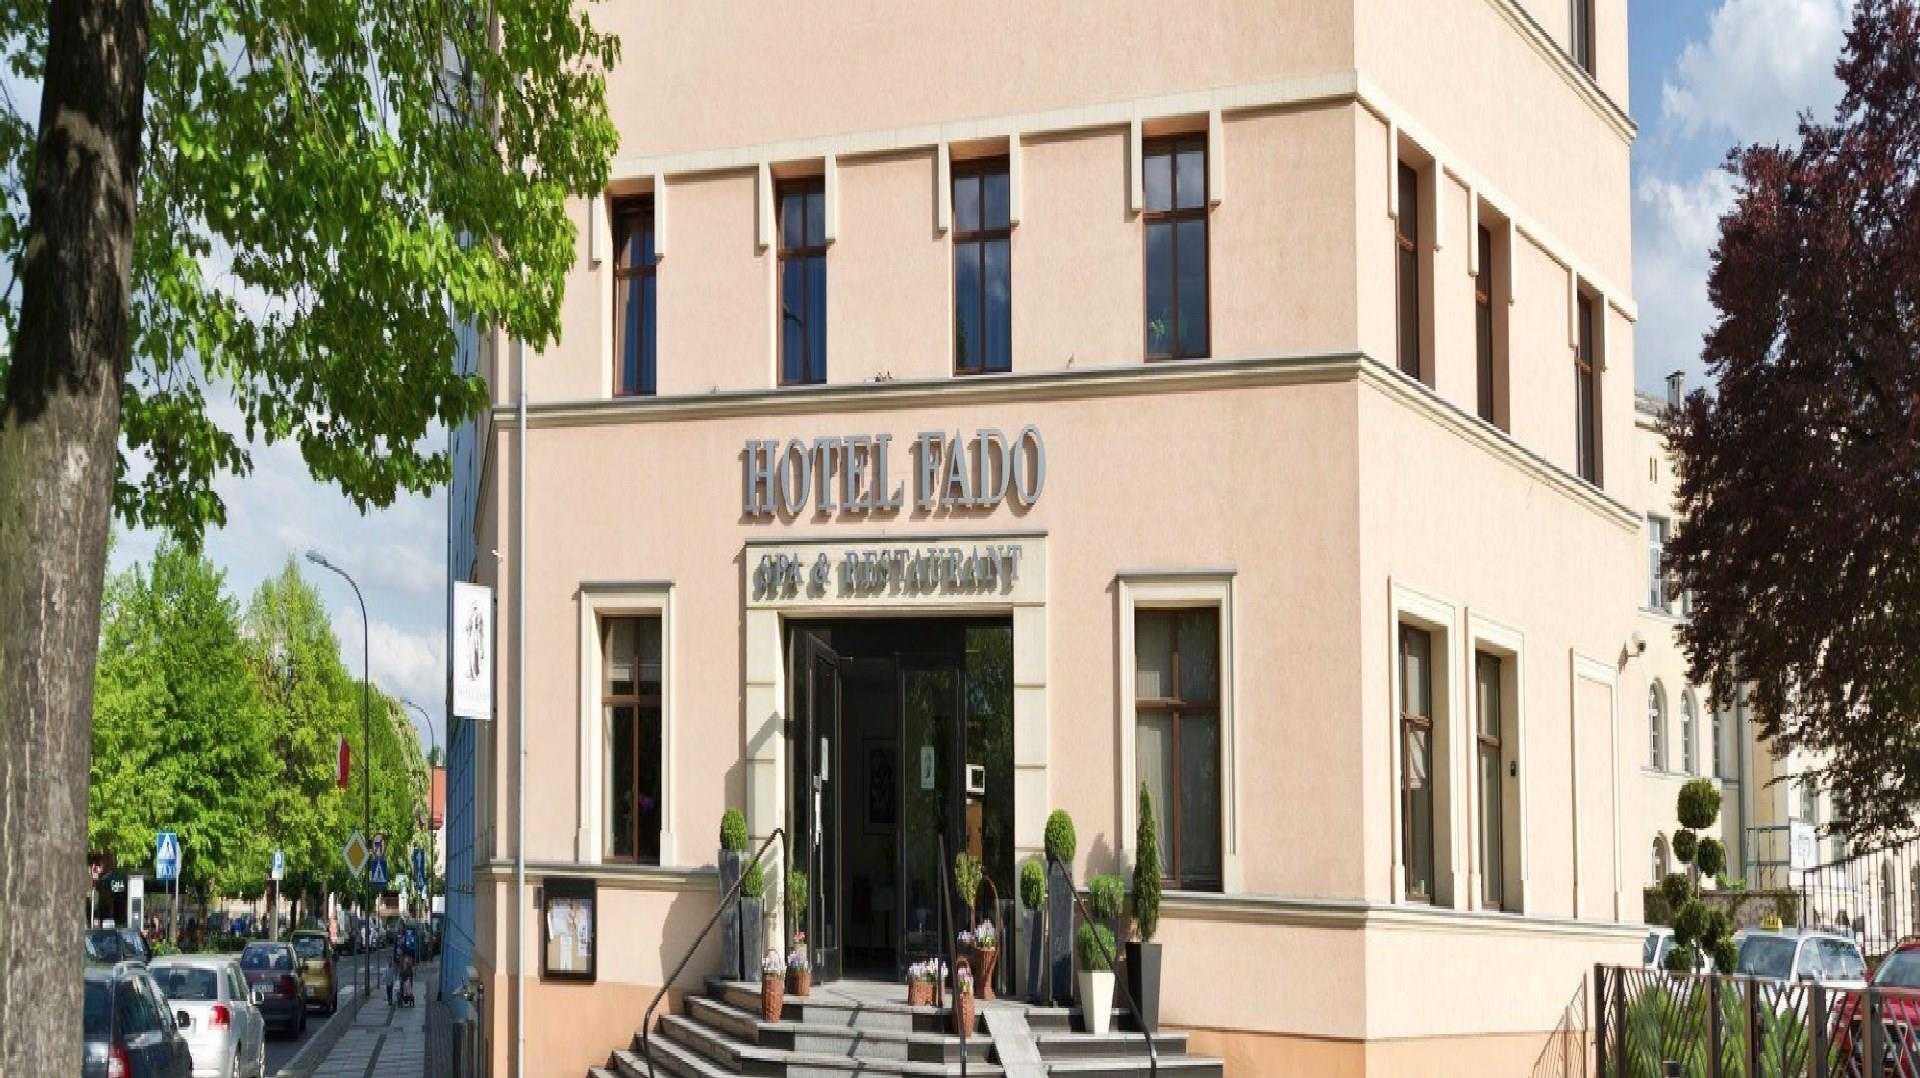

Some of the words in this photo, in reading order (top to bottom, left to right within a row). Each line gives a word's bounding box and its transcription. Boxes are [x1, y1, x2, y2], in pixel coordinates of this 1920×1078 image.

[745, 430, 904, 513] HOTEL
[917, 423, 1047, 508] FADO
[757, 552, 805, 590] SPA
[843, 545, 1023, 588] RESTAURANT
